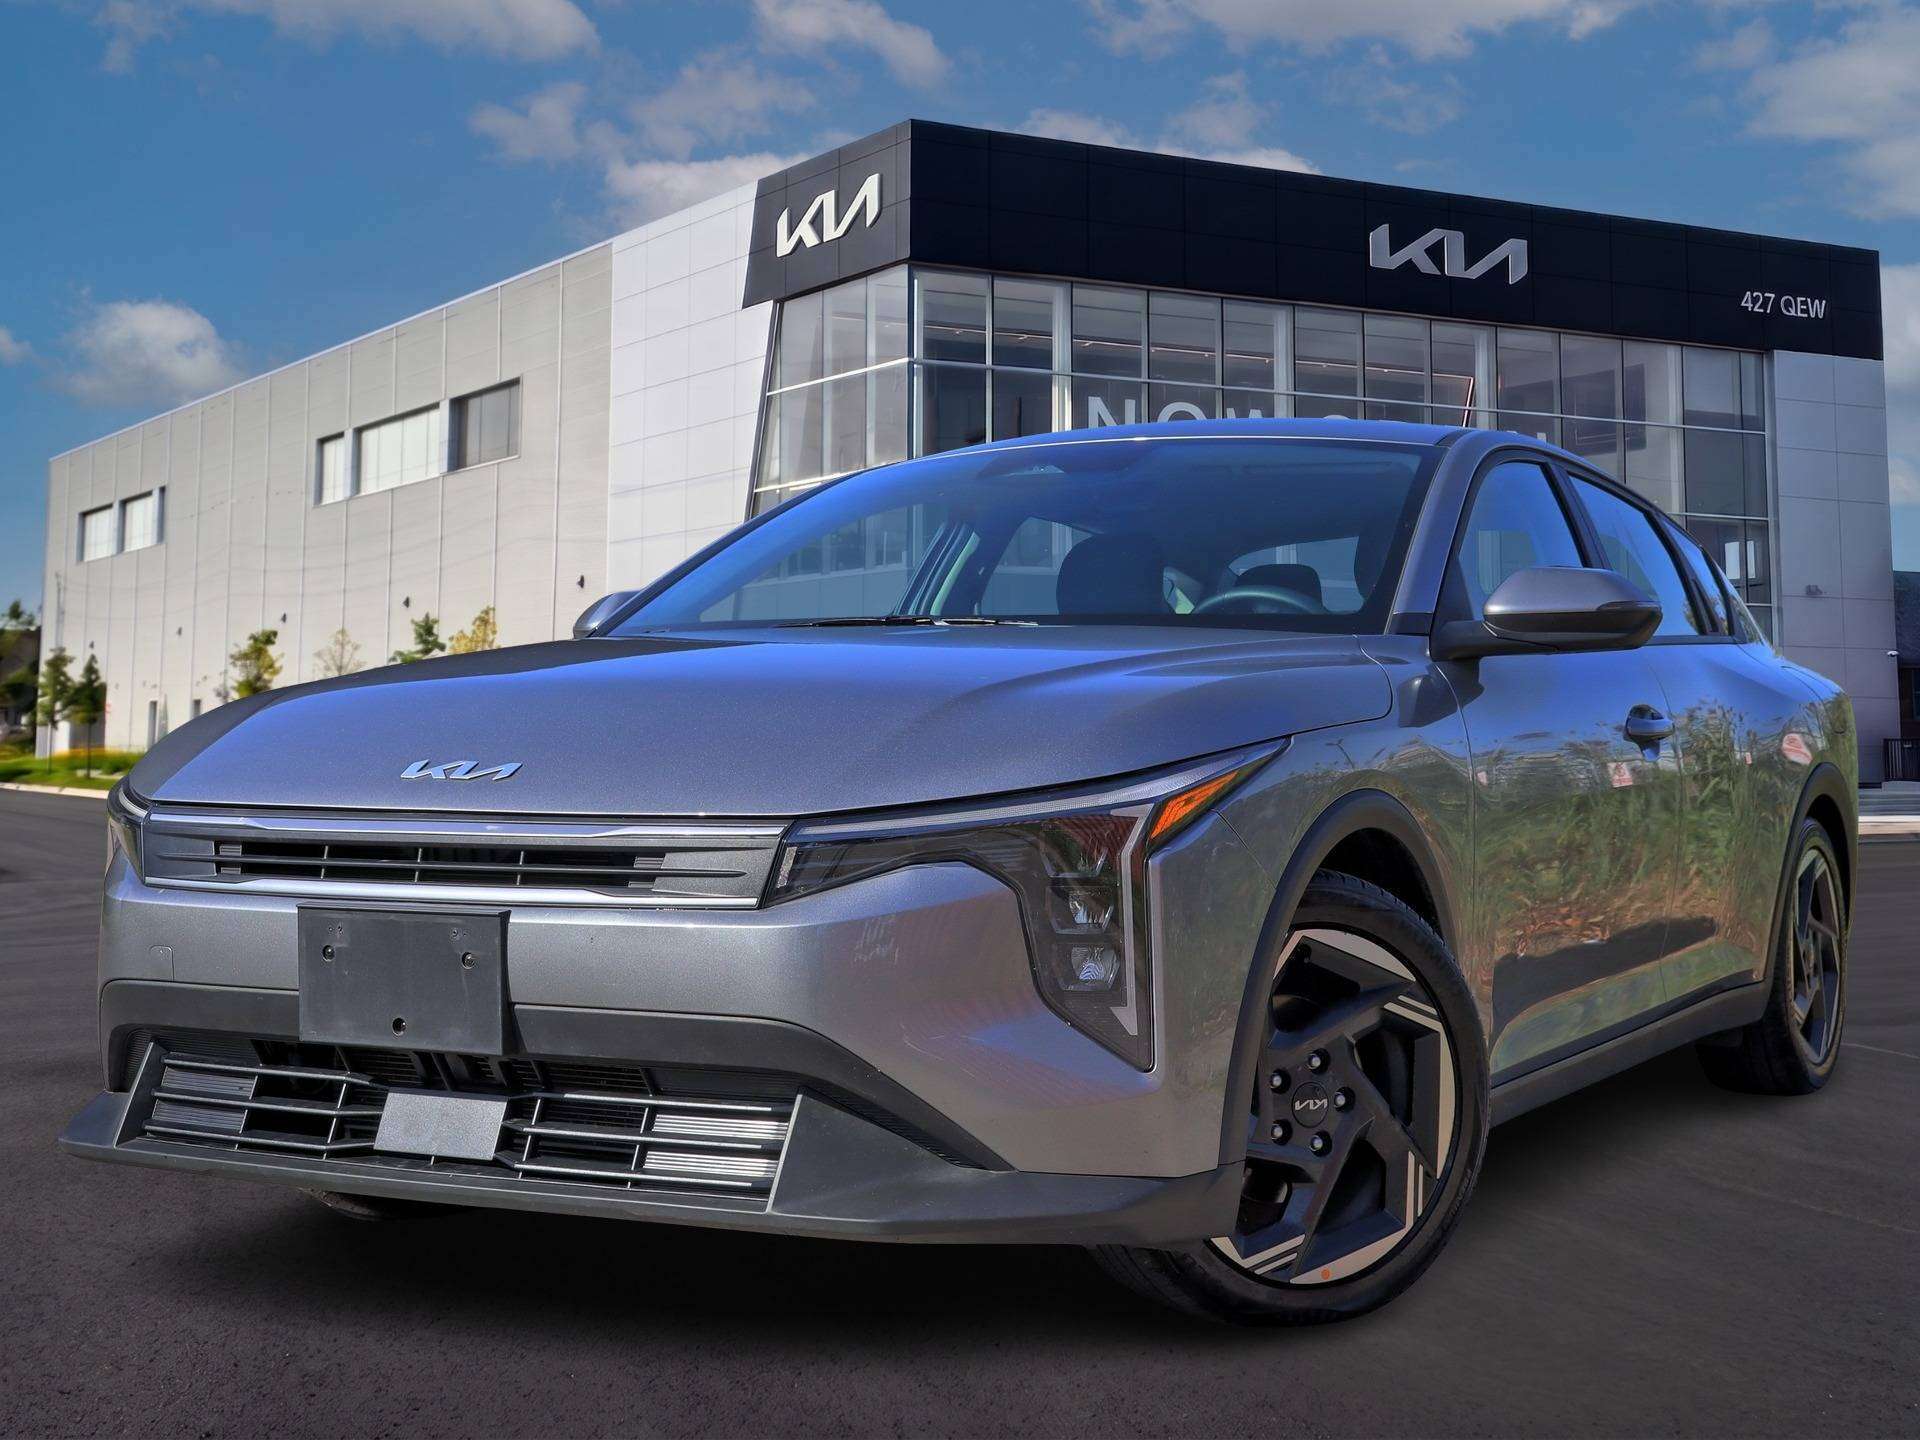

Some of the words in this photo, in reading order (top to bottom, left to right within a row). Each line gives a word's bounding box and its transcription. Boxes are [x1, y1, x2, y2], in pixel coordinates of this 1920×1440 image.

[777, 173, 880, 257] KIA
[1370, 223, 1528, 285] KIA
[1741, 291, 1776, 313] 427
[1780, 295, 1826, 318] QEW
[400, 759, 523, 780] KIA
